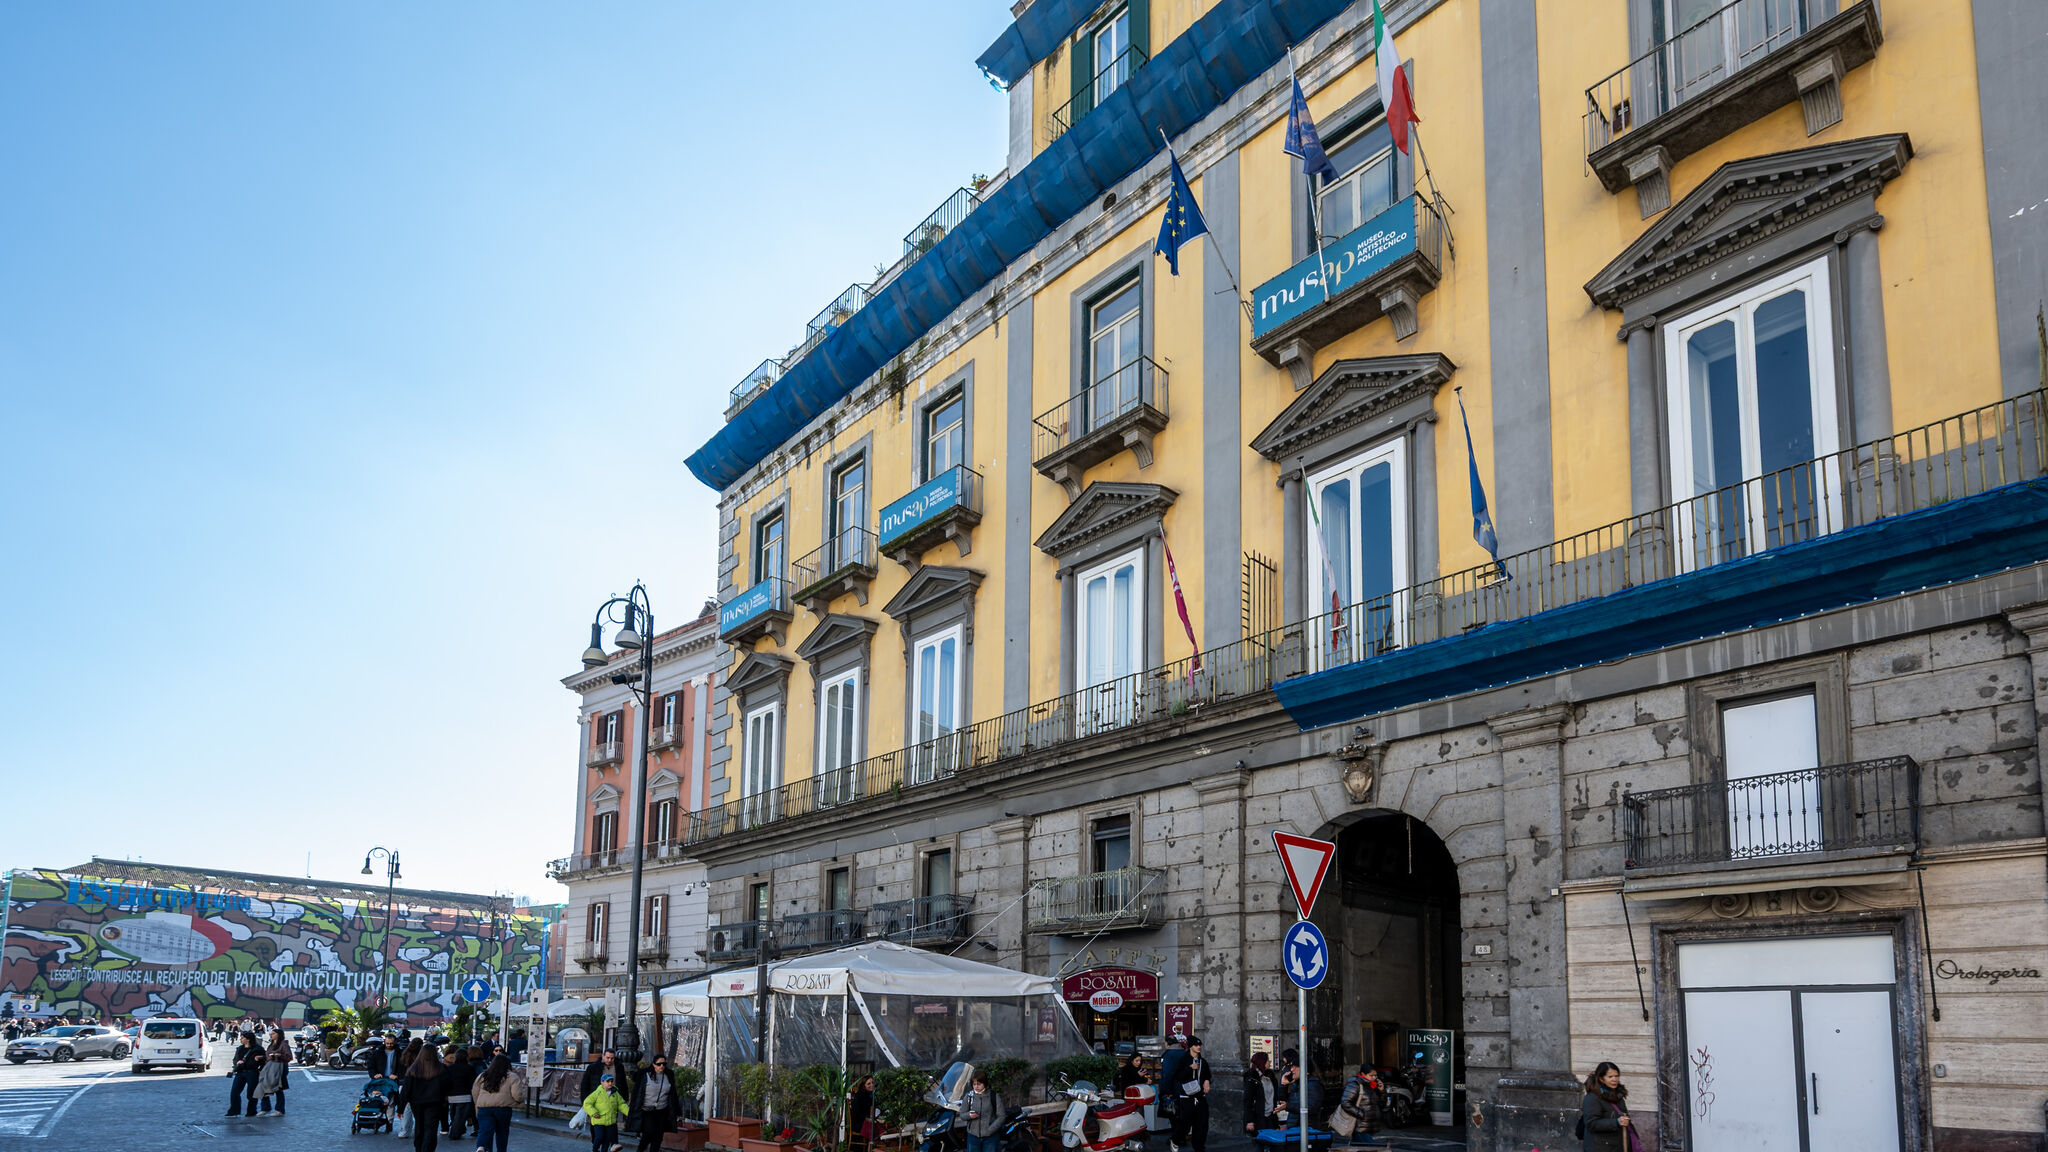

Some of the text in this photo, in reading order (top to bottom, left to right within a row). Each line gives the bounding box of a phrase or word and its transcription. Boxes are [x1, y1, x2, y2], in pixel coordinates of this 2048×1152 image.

[1357, 230, 1384, 250] MUSEO
[1357, 230, 1396, 258] ARTISTICO
[1357, 232, 1407, 266] POLITECNICO
[1261, 251, 1355, 320] musap
[883, 495, 929, 533] musap
[66, 877, 193, 909] ESERCITO
[50, 969, 86, 982] L'ESERCIT
[86, 969, 142, 984] CONTRIBUISCE
[143, 970, 154, 984] AL
[156, 970, 207, 986] RECUPERO
[210, 971, 231, 987] DEL
[234, 971, 312, 989] PATRIMONIO
[316, 972, 410, 992] CULTURALE
[785, 973, 831, 990] ROSATI
[1080, 976, 1136, 990] ROSATI
[1936, 959, 2042, 985] Orologeria
[1092, 996, 1120, 1005] MORENO
[1409, 1033, 1448, 1046] musap
